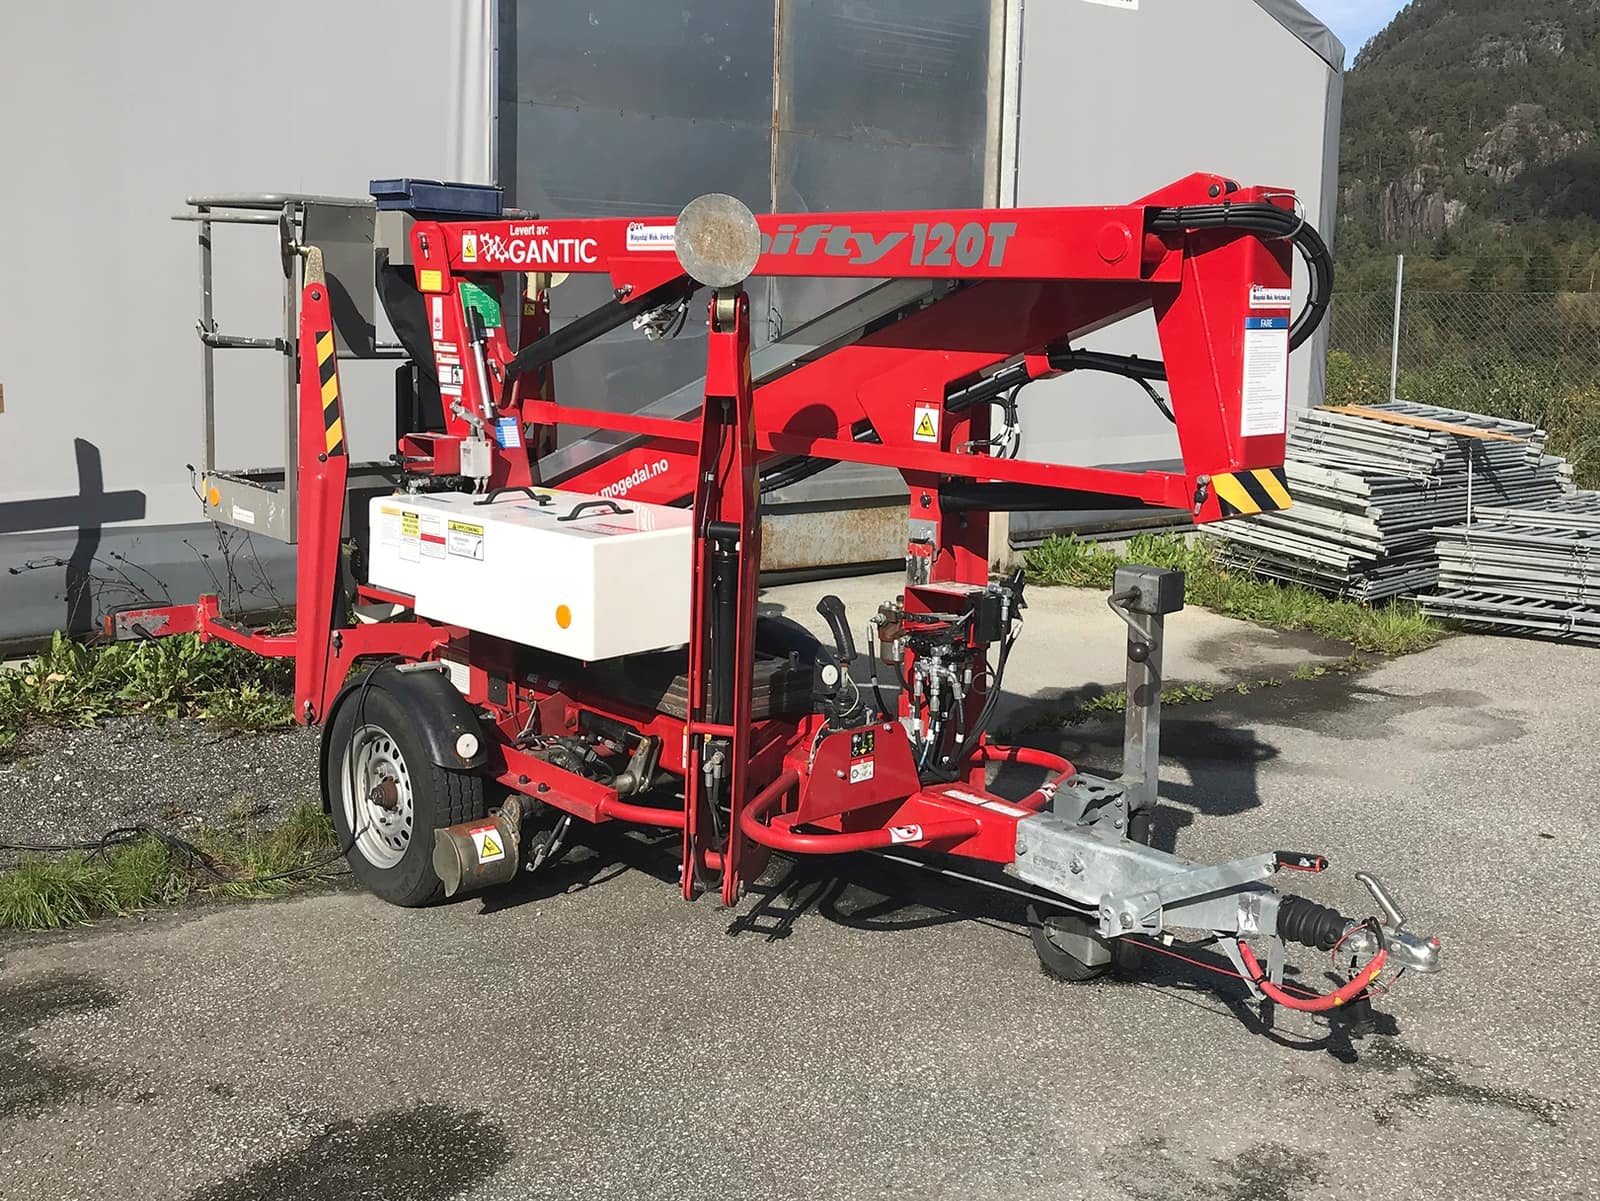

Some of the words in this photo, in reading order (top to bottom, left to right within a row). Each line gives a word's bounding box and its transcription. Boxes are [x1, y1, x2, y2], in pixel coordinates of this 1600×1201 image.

[509, 224, 535, 236] Levert
[536, 226, 549, 235] av:
[509, 238, 598, 264] GANTIC
[910, 222, 1017, 268] 120T
[1260, 318, 1273, 328] FARE
[592, 459, 669, 498] mogedal.no
